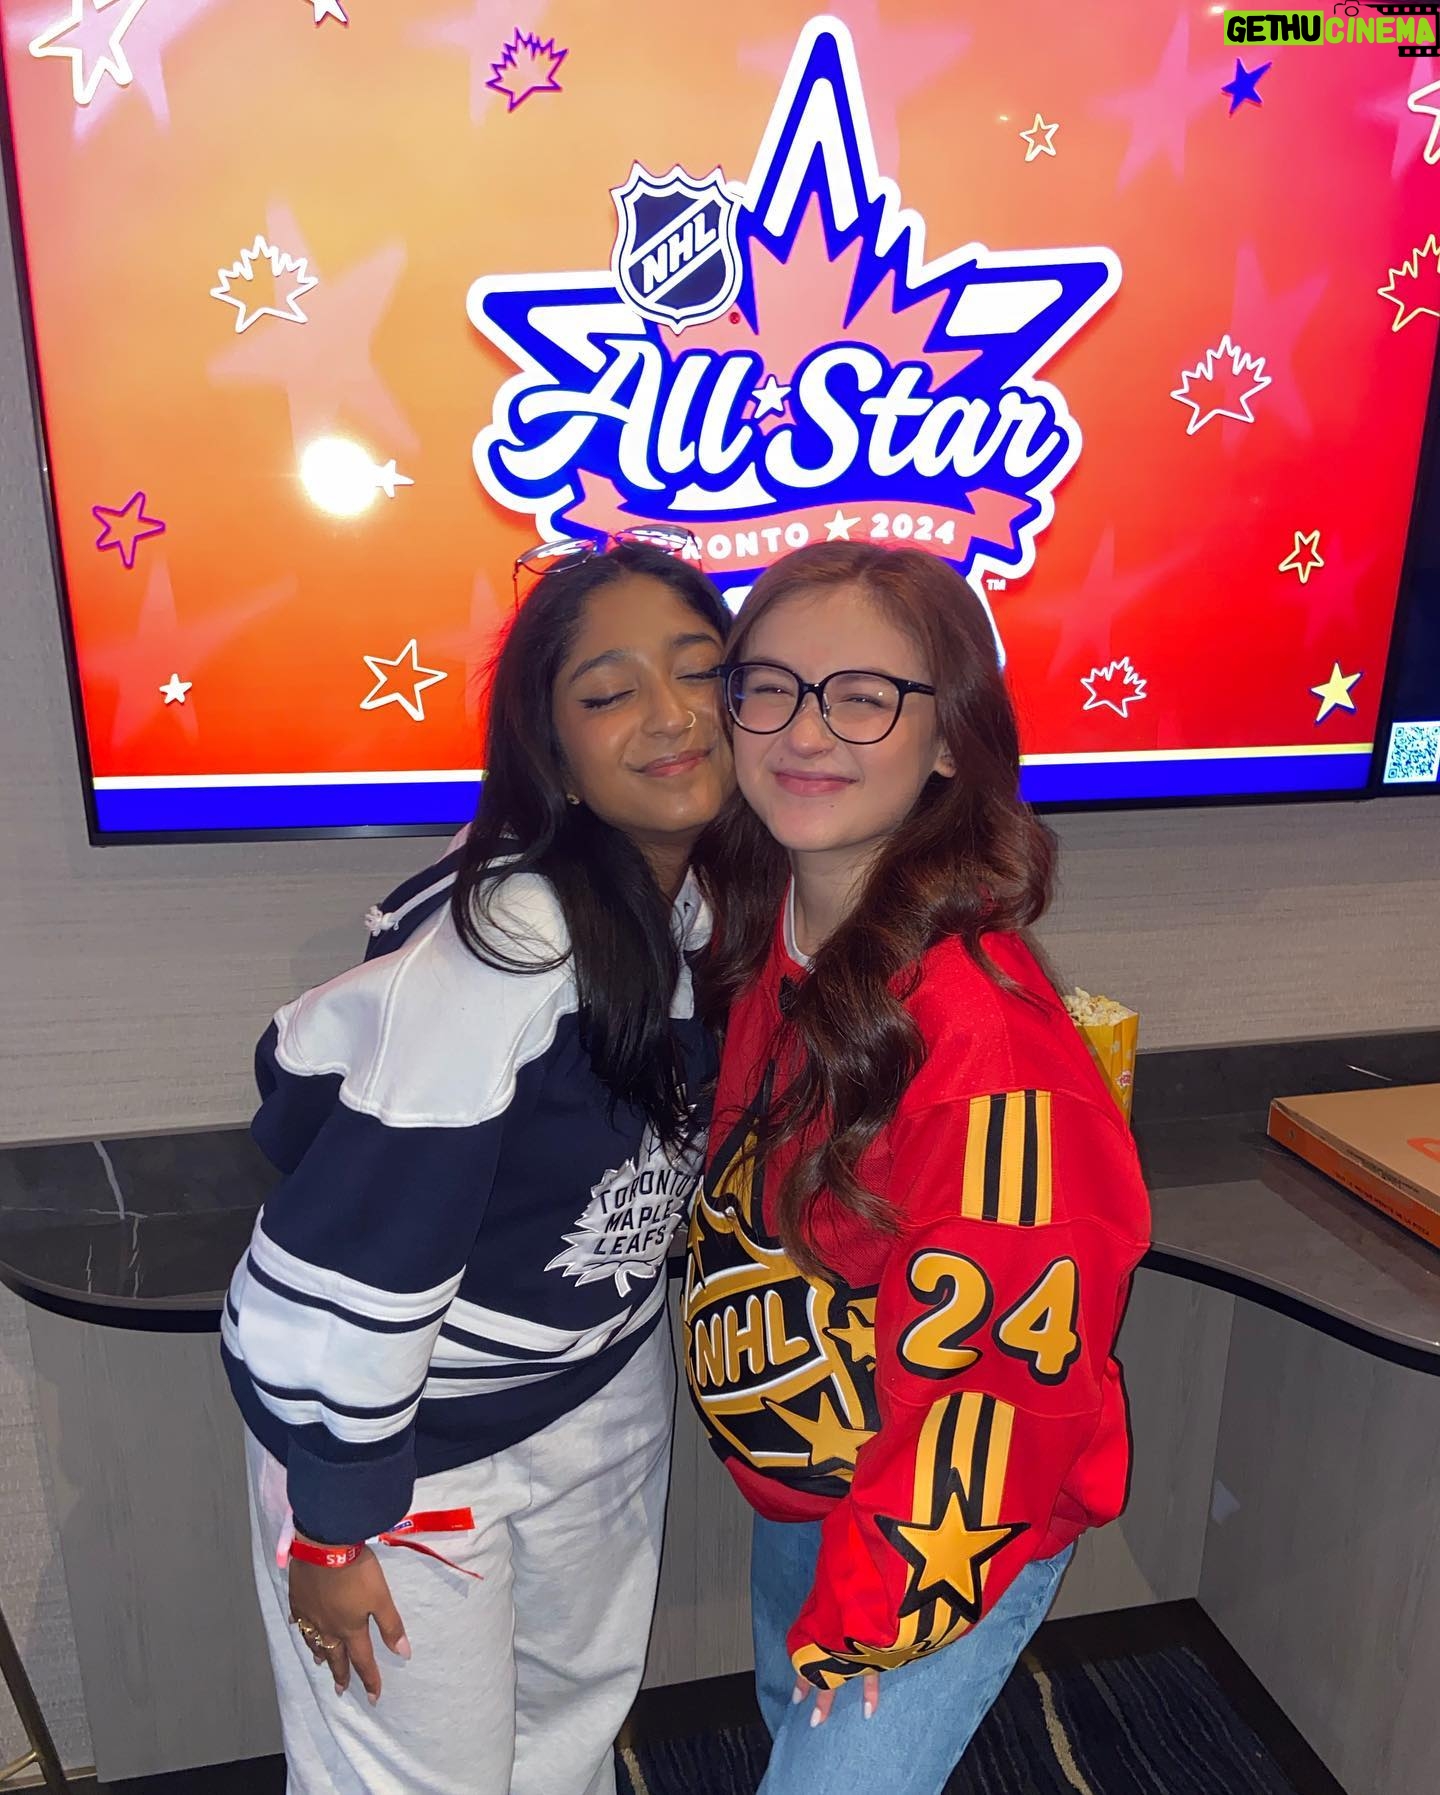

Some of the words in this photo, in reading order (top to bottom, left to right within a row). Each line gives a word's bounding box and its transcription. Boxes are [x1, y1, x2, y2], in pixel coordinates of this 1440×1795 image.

[641, 212, 717, 294] NHL
[765, 348, 1061, 488] Star
[634, 523, 809, 560] RONTO
[869, 512, 956, 545] 2024
[600, 1169, 692, 1214] TORONTO
[604, 1199, 674, 1234] MAPLE
[593, 1225, 667, 1255] LEAFS
[695, 1289, 811, 1388] NHL
[898, 1248, 1081, 1386] 24
